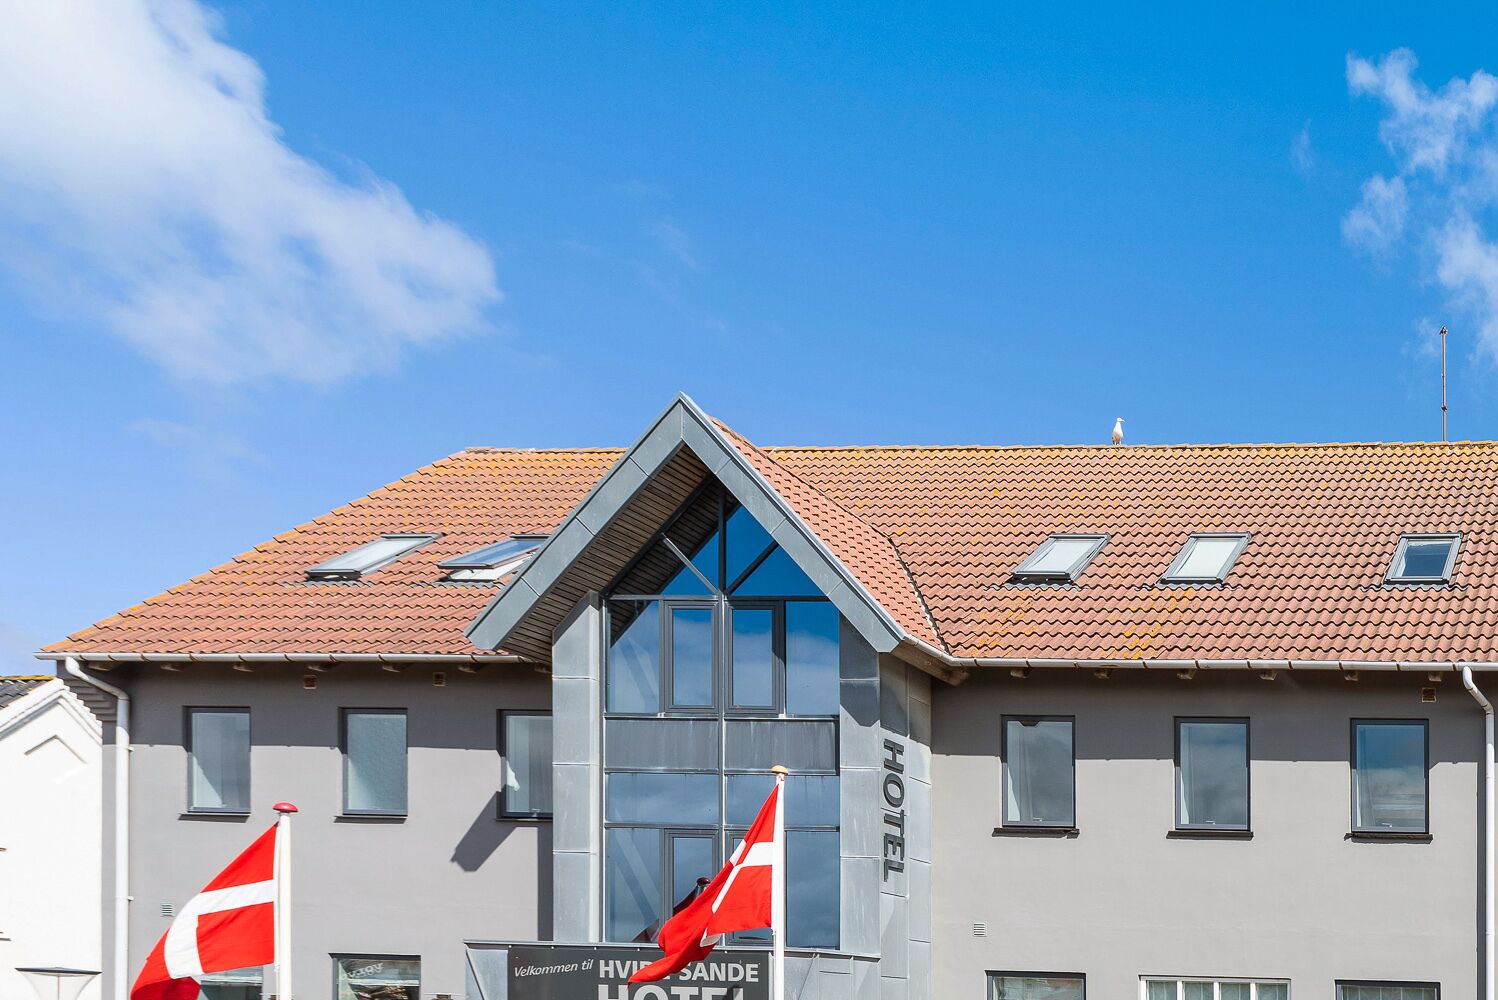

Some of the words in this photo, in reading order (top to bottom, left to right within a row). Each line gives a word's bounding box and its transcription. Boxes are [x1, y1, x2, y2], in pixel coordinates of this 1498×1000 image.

[883, 738, 905, 883] HOTEL
[514, 963, 578, 977] Velkommen
[581, 959, 594, 971] til
[599, 959, 670, 980] HVI
[679, 962, 759, 982] SANDE
